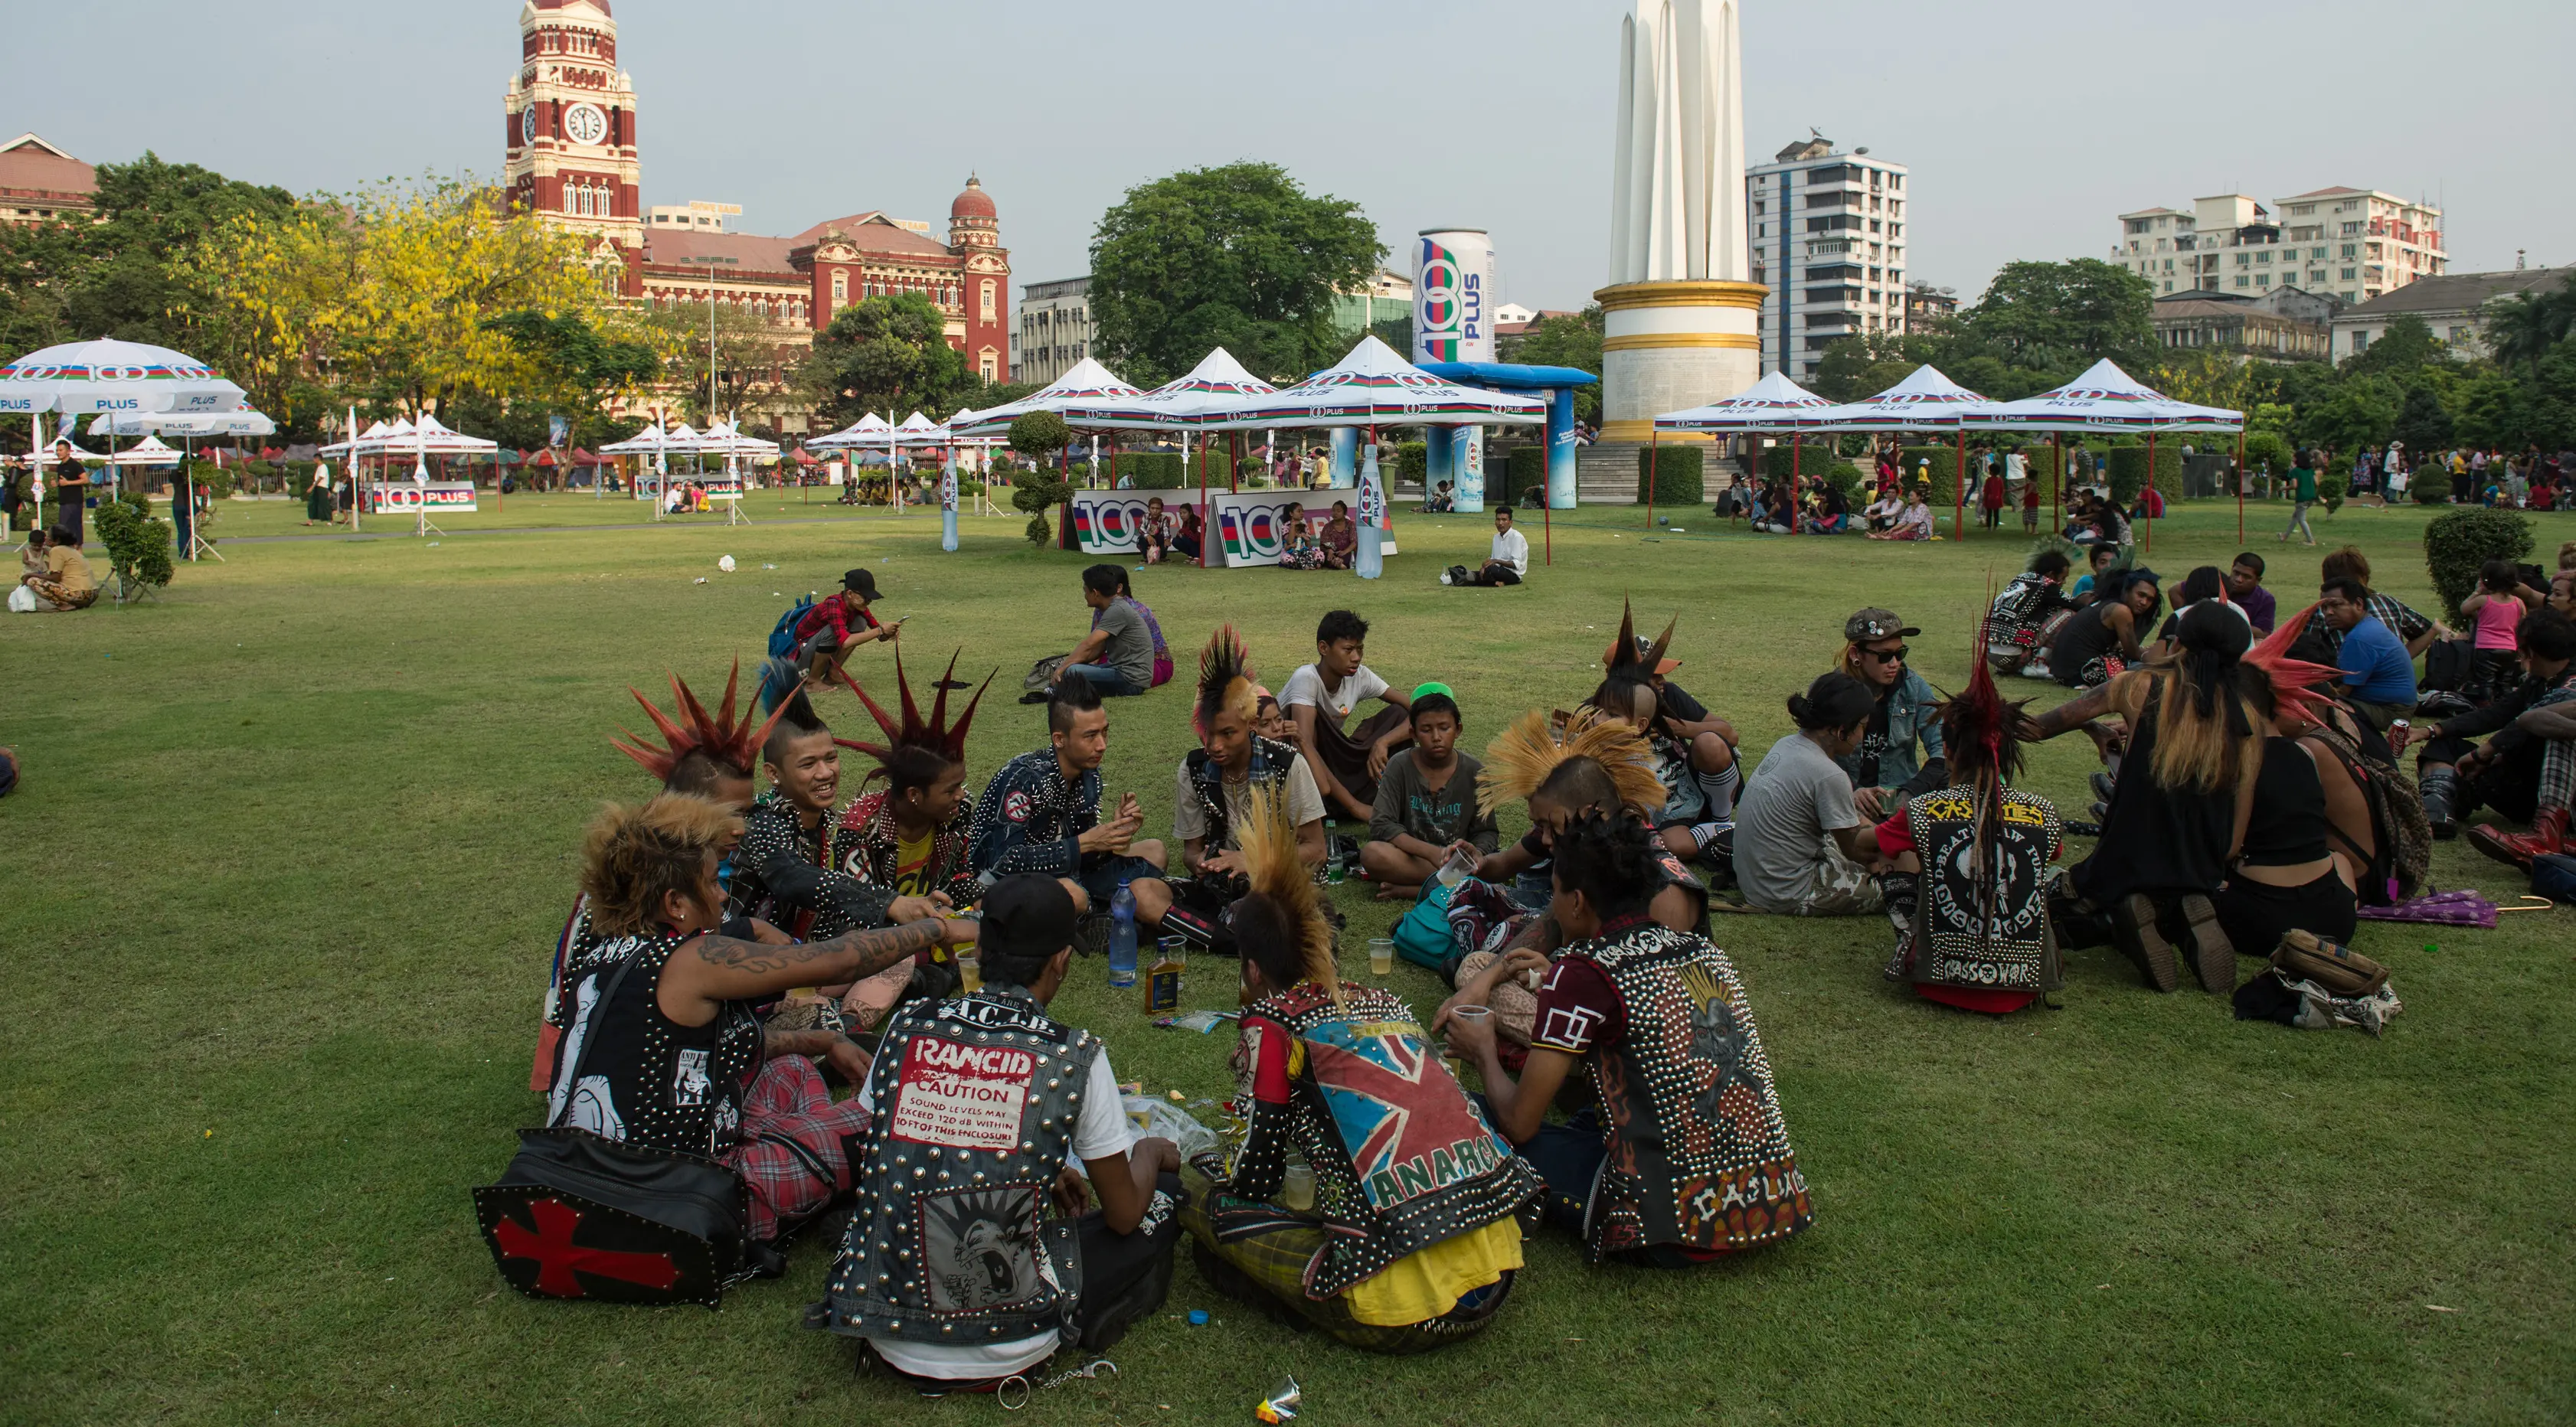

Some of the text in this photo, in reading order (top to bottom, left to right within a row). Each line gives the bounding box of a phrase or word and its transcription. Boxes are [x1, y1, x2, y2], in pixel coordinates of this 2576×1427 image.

[1419, 258, 1462, 348] 100
[1464, 273, 1480, 339] PLUS
[4, 363, 63, 383] 100
[83, 363, 149, 383] 100
[1381, 371, 1443, 390] 100
[1286, 388, 1335, 397] PLUS
[1878, 392, 1926, 406] 100
[2055, 387, 2108, 402] 100
[0, 399, 31, 410] PLUS
[96, 399, 139, 410] PLUS
[191, 395, 218, 405] PLUS
[1727, 397, 1771, 410] 100
[1085, 408, 1099, 421] 100
[1227, 410, 1242, 423] 100
[1309, 405, 1344, 420] 100 PLUS
[1404, 403, 1421, 416] 100
[1490, 404, 1507, 416] 100
[1154, 412, 1169, 425] 100
[1675, 419, 1689, 428] 100
[1746, 419, 1760, 429] 100
[1821, 417, 1836, 426] 100
[1902, 416, 1918, 426] 100
[1991, 413, 2009, 423] 100
[2085, 414, 2105, 425] 100
[427, 491, 469, 504] PLUS
[1359, 485, 1373, 520] 100
[1078, 499, 1149, 548] 100
[1934, 827, 1970, 880] D-BEAT
[976, 993, 998, 1002] COPS
[1001, 998, 1020, 1008] ARE
[955, 1000, 1055, 1034] A.C.A.B.
[914, 1038, 1032, 1076] RANCID
[917, 1080, 1009, 1103] CAUTION
[910, 1097, 1007, 1118] SOUND LEVELS MAY
[900, 1107, 1013, 1131] EXCEED 120 dB WITHIN
[908, 1120, 920, 1128] FT
[920, 1122, 933, 1131] OF
[935, 1125, 956, 1135] THIS
